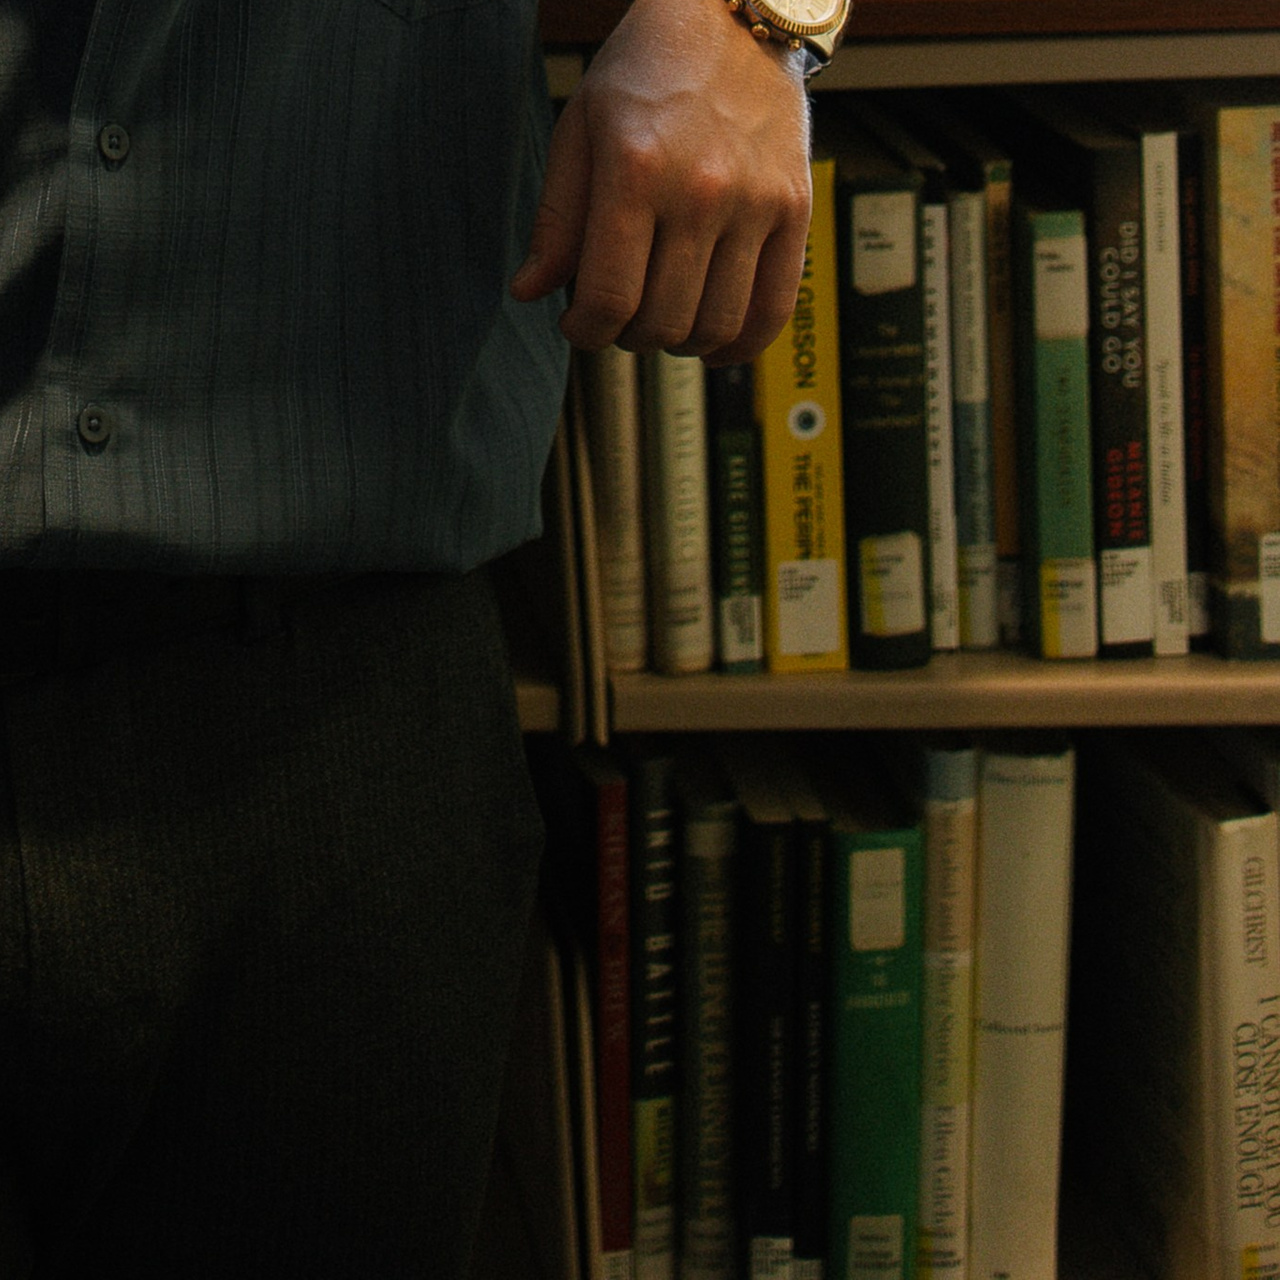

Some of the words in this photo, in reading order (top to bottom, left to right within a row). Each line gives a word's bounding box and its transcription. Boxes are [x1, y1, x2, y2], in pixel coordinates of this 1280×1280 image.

[1121, 222, 1140, 264] DID
[1122, 269, 1140, 280] I
[1101, 247, 1122, 329] COULD
[1123, 288, 1141, 328] SAY
[794, 286, 818, 391] GIBSON
[1102, 335, 1122, 374] GO
[1123, 335, 1143, 389] YOU
[793, 453, 813, 492] THE
[1106, 448, 1126, 537] GIDEON
[1126, 441, 1145, 541] MELANIE
[1242, 855, 1269, 967] GILCHRIST
[1232, 1022, 1259, 1096] CLOSE
[934, 1106, 958, 1160] Ellen
[1235, 1106, 1265, 1211] ENOUGH
